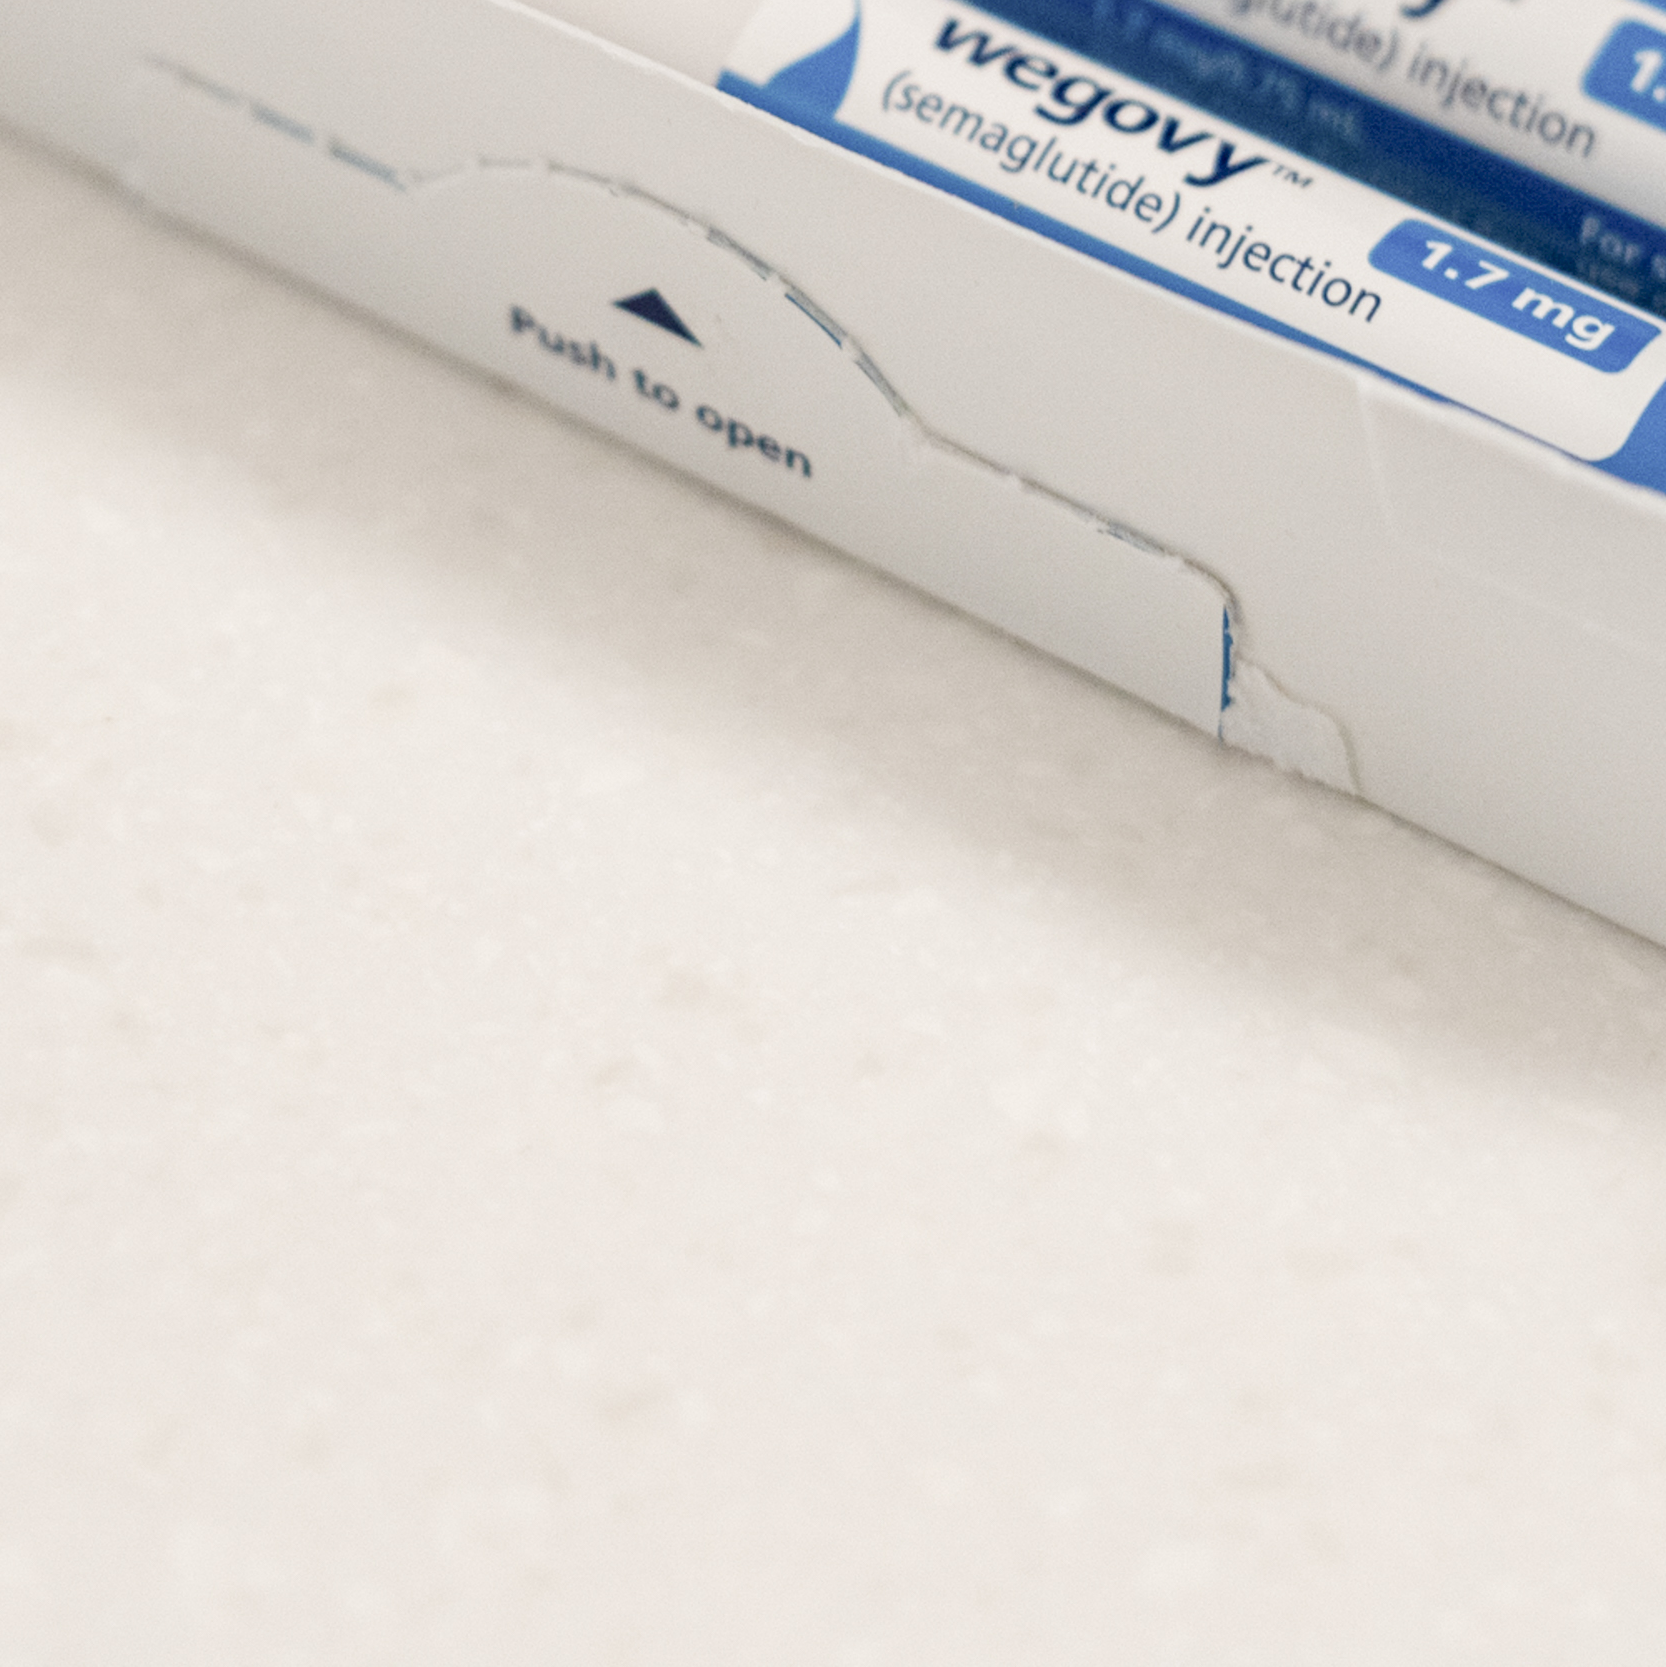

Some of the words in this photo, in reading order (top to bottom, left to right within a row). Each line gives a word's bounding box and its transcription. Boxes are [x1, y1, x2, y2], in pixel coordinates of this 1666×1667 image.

[1407, 38, 1595, 162] injection
[882, 70, 1183, 236] (semaglutide)
[1185, 206, 1383, 324] injection
[1579, 216, 1641, 264] For
[1421, 239, 1511, 290] 1.7
[1511, 286, 1617, 352] mg
[509, 303, 617, 383] Push
[632, 368, 680, 412] to
[694, 404, 813, 479] open
